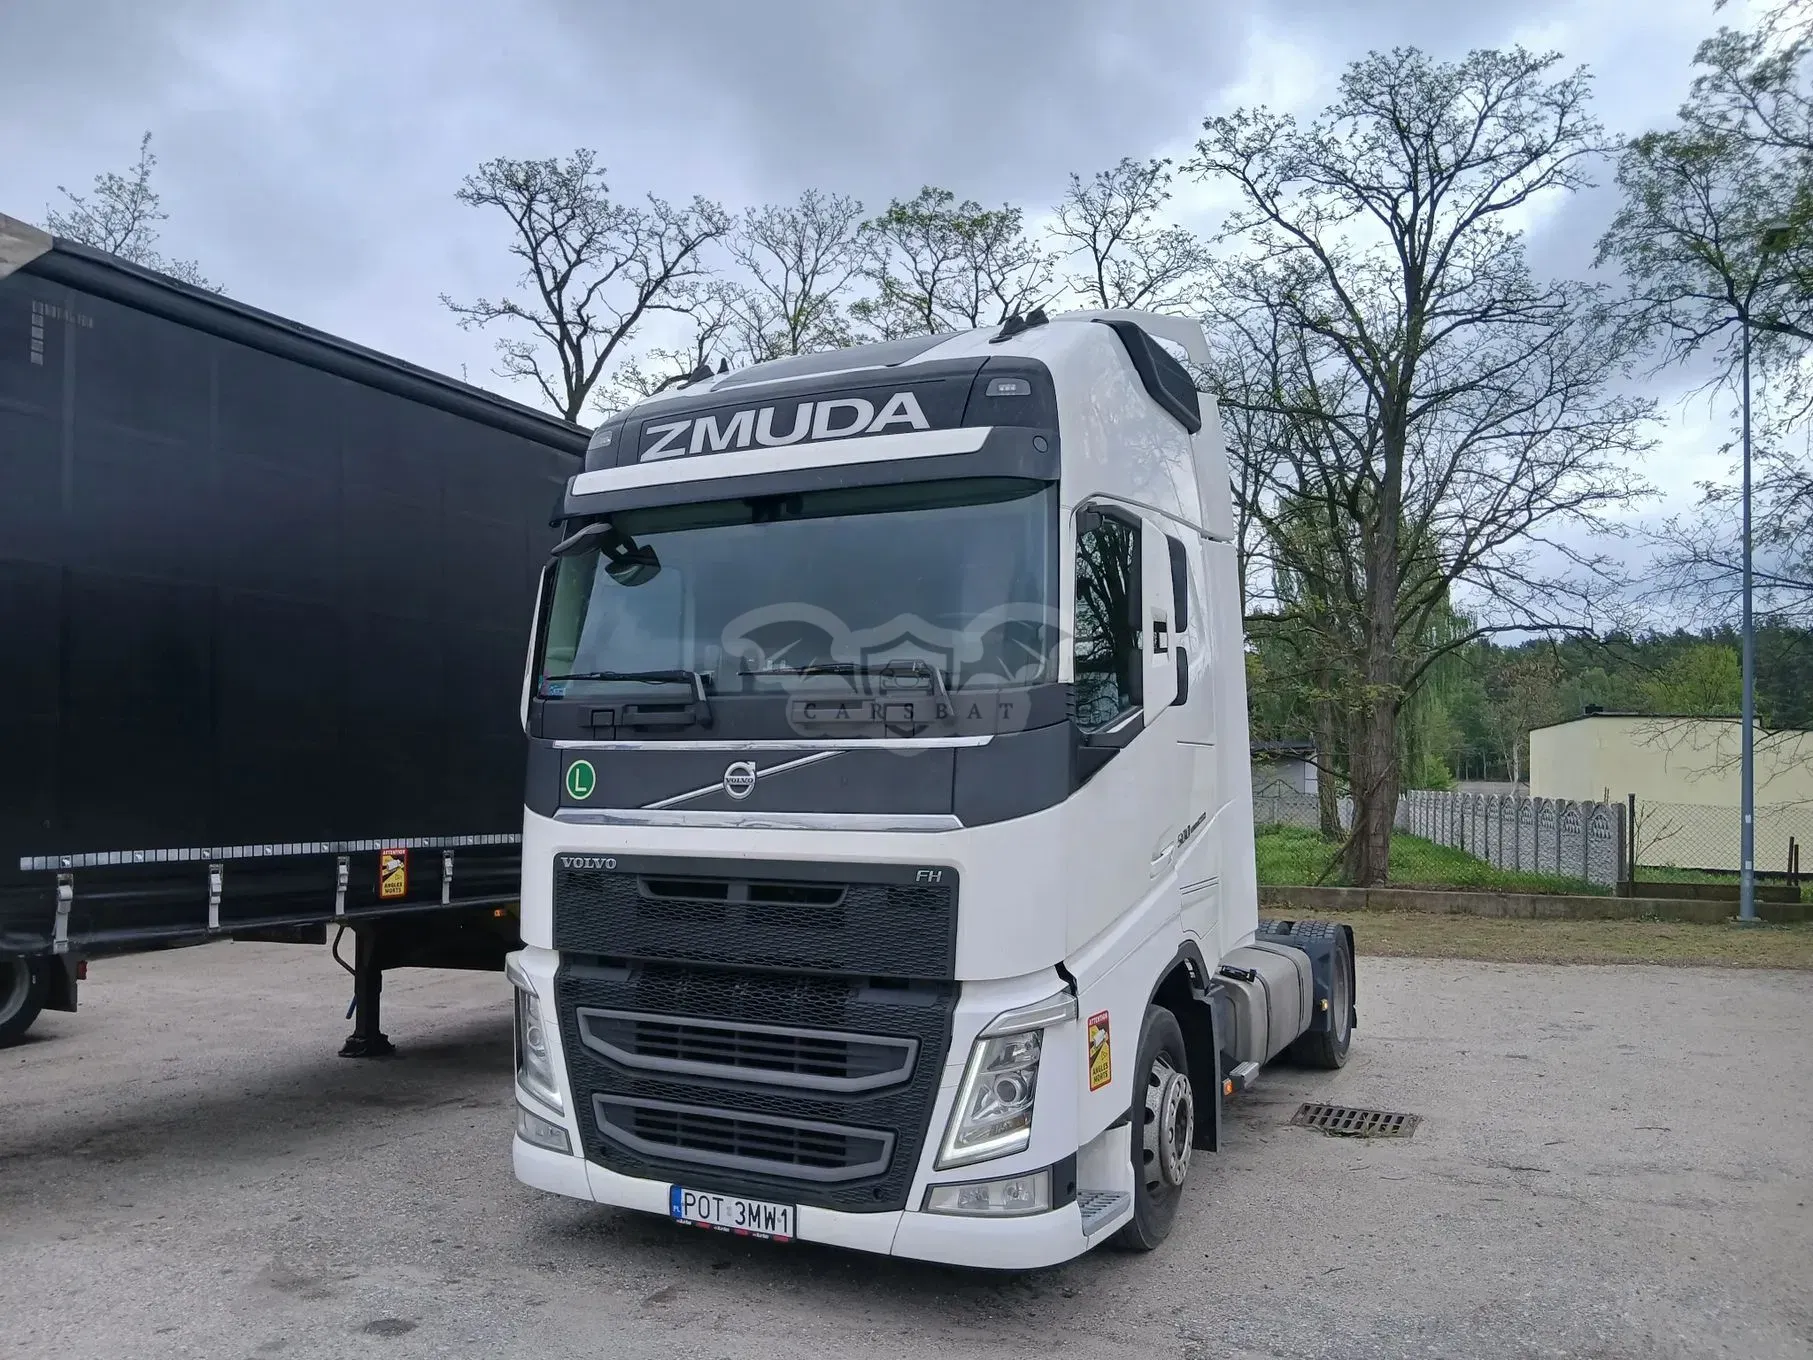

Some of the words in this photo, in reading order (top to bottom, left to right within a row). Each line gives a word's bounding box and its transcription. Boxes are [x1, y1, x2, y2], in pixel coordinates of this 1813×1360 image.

[640, 391, 930, 463] ZMUDA
[575, 768, 587, 792] L
[560, 857, 617, 870] VOLVO
[915, 870, 942, 883] FH
[685, 1193, 724, 1221] POT
[735, 1201, 788, 1233] 3MW1
